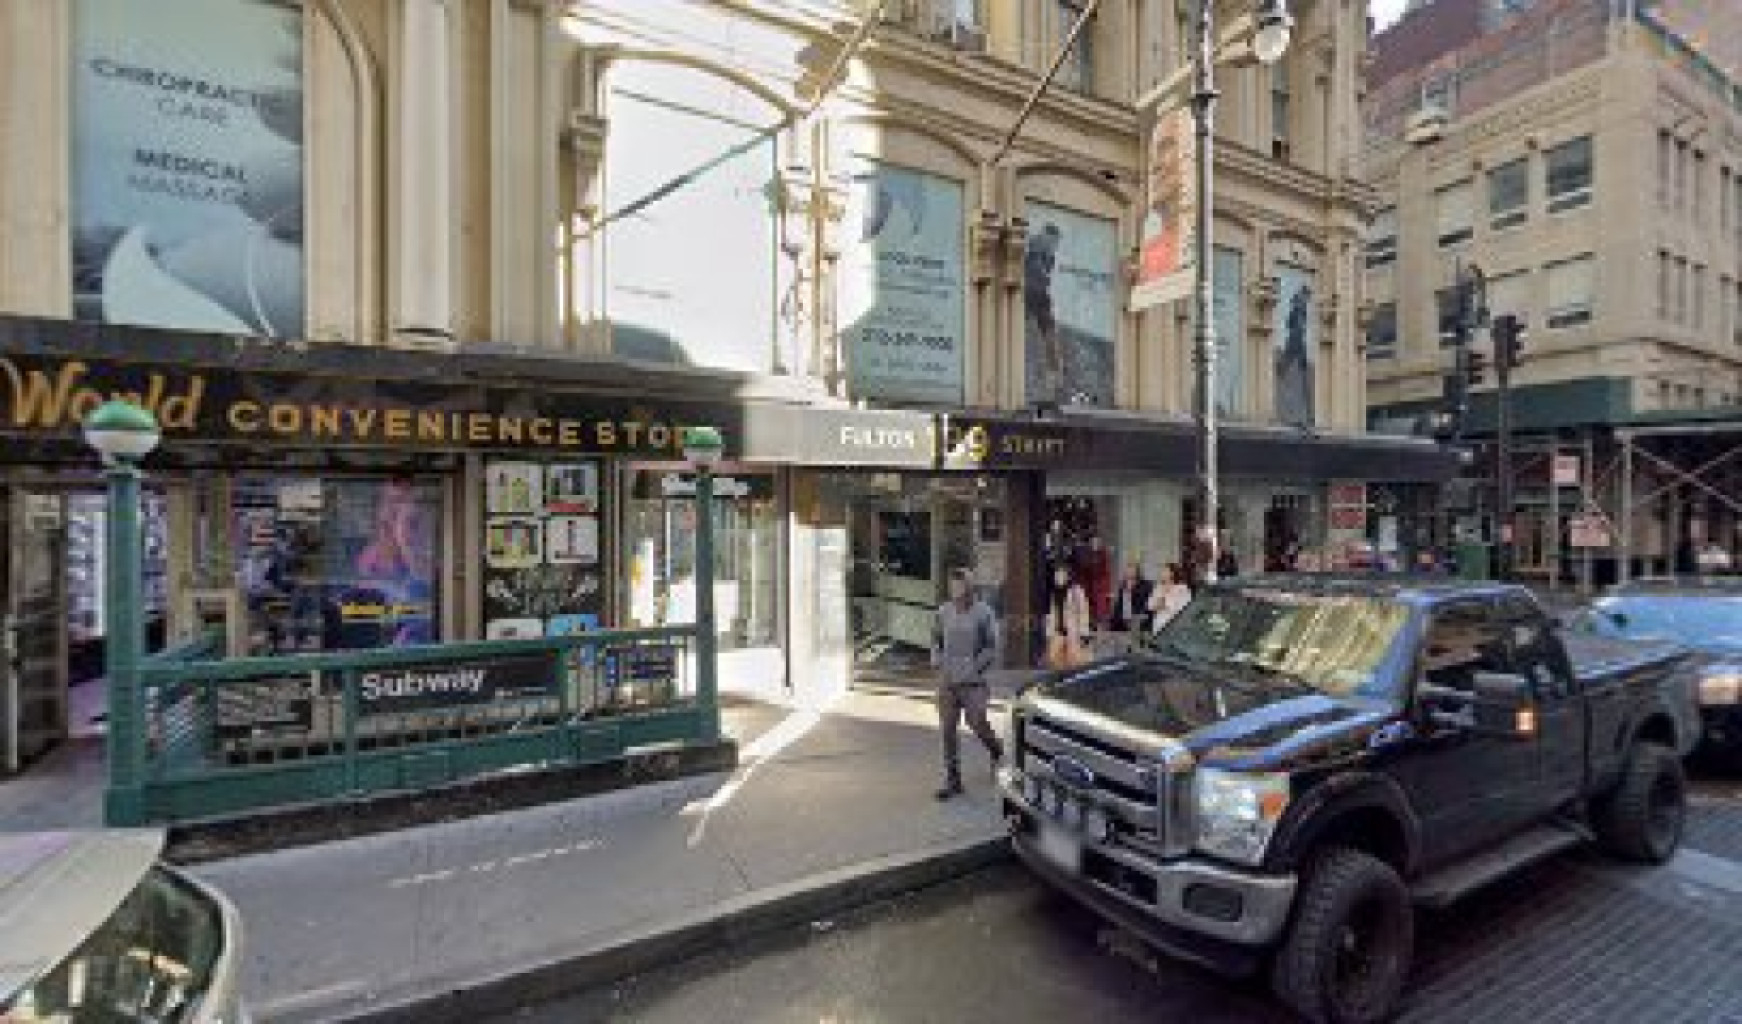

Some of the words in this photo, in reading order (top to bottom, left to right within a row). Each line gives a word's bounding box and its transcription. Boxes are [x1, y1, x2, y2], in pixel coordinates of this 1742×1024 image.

[135, 149, 248, 184] MEDICAL
[226, 400, 582, 445] CONVENIENCE
[596, 421, 685, 447] STO
[360, 668, 488, 700] Subway
